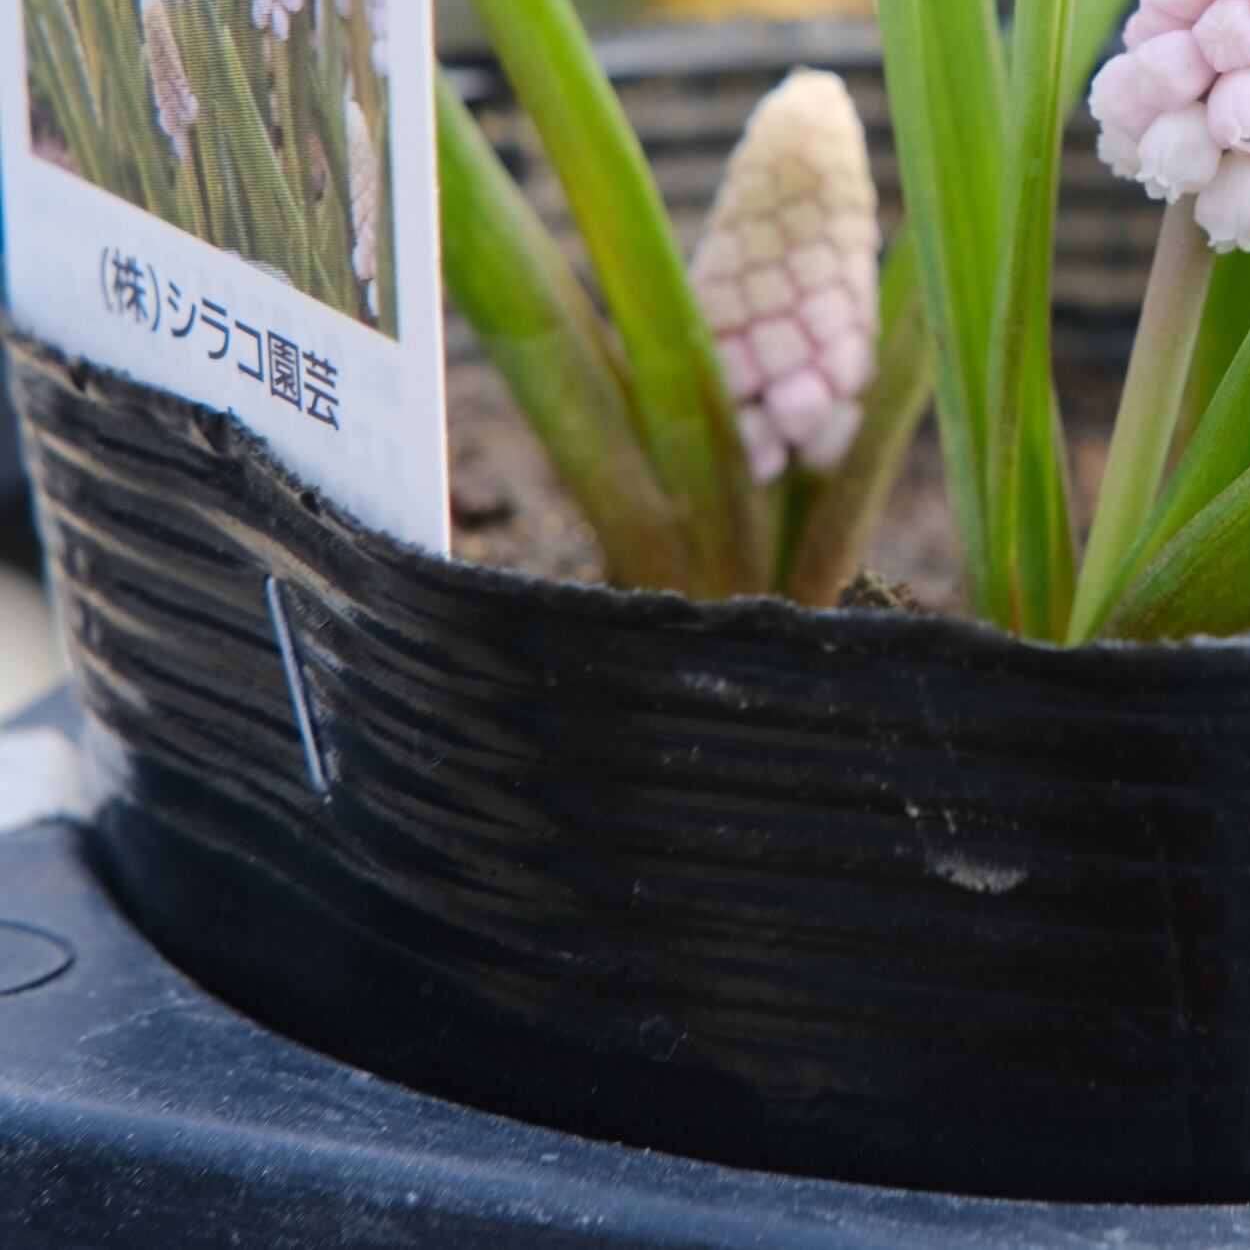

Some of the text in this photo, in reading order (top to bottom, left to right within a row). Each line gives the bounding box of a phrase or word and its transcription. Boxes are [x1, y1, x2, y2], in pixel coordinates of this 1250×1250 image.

[100, 246, 340, 432] (株)シラコ園芸
